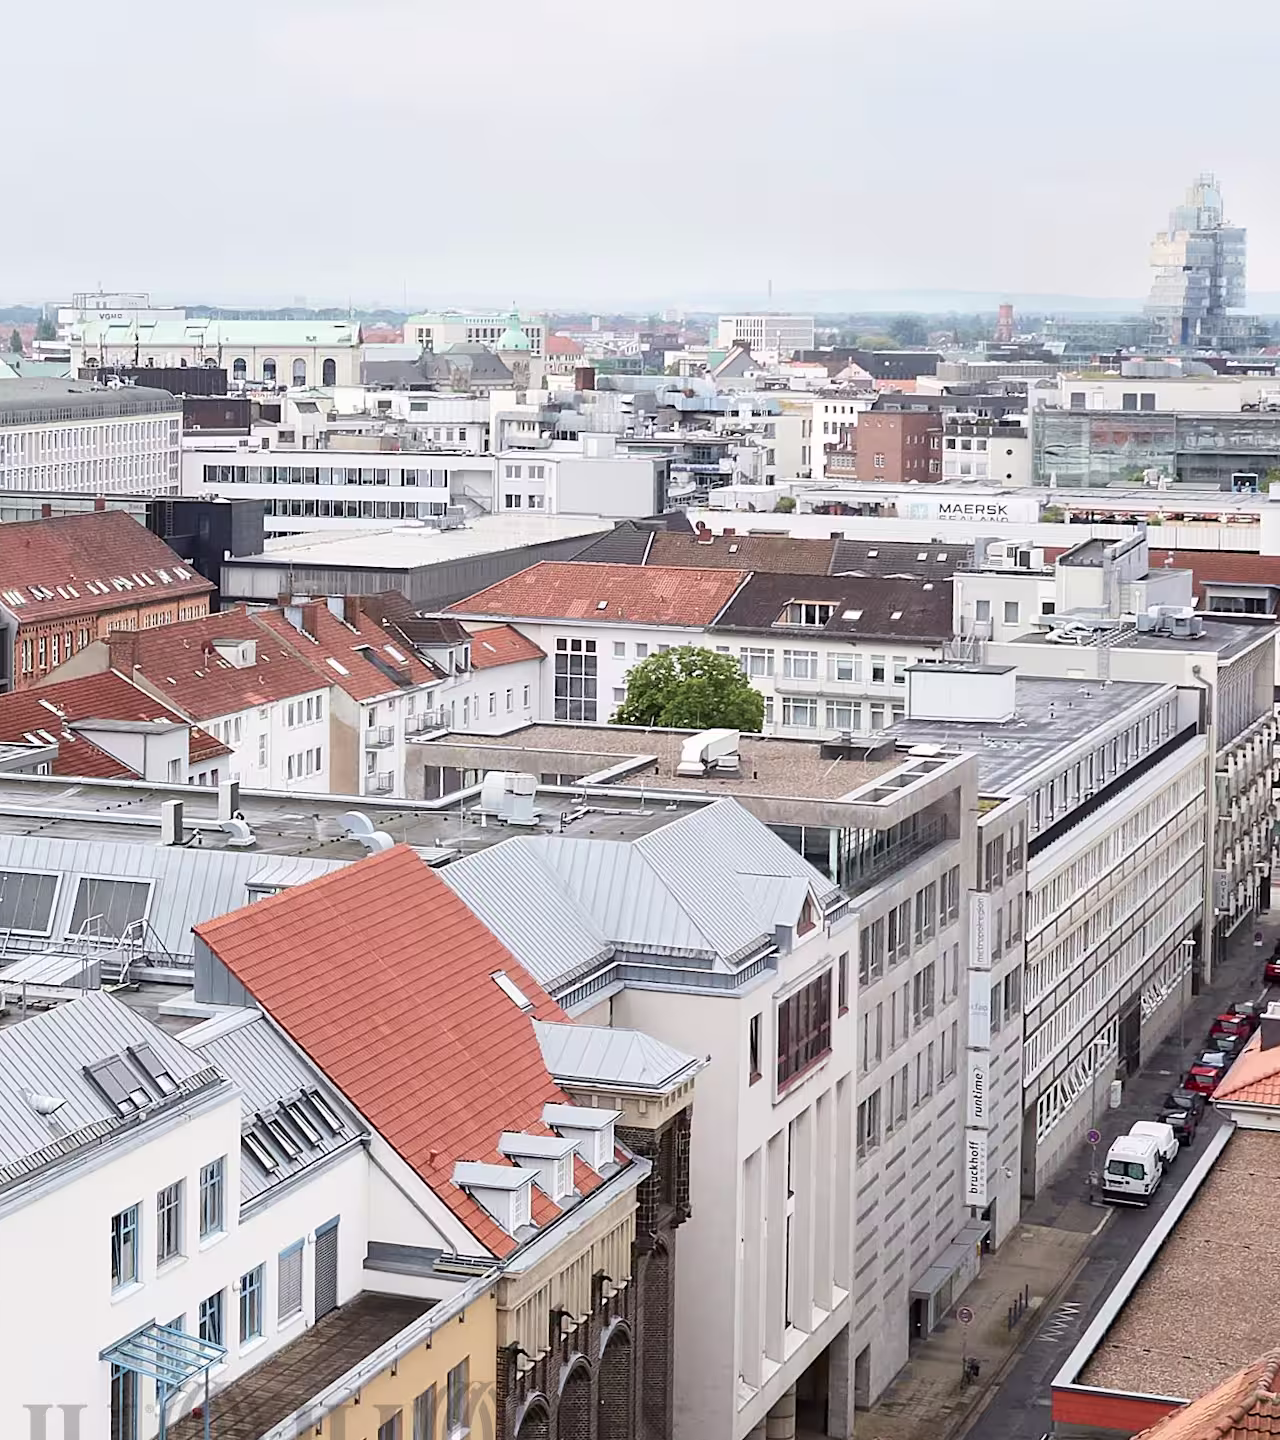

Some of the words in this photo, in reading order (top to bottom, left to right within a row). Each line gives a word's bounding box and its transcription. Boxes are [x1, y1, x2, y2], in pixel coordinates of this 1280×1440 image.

[939, 503, 1008, 516] MAERSK
[972, 1072, 984, 1118] runtime
[968, 1140, 979, 1194] bruckhoff
